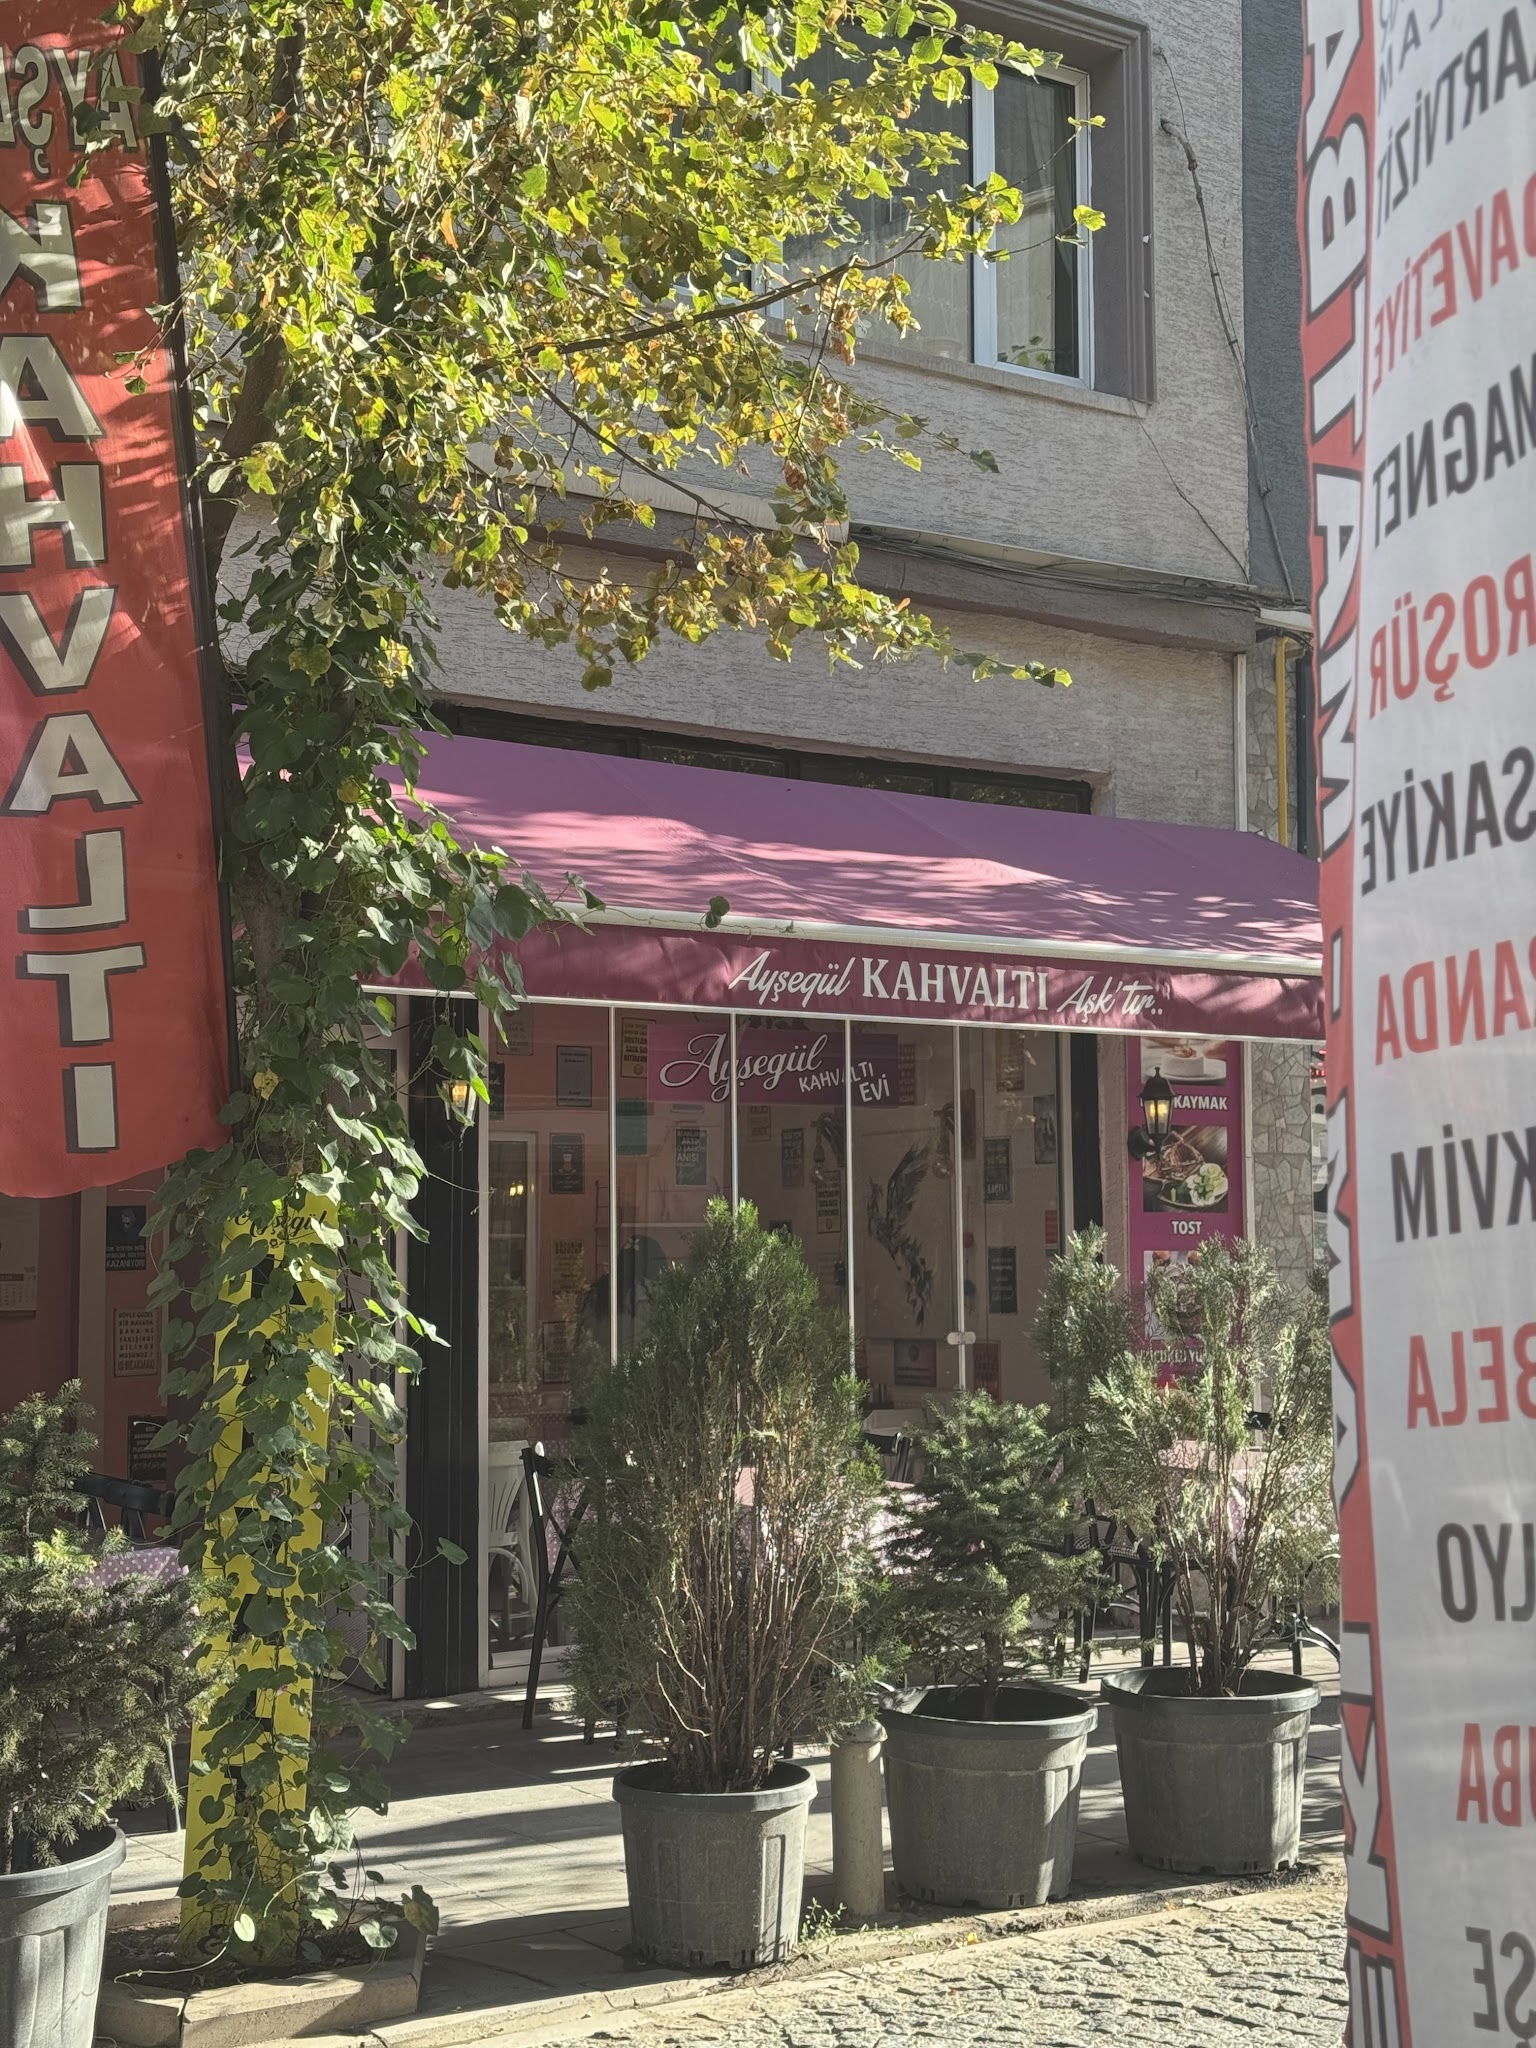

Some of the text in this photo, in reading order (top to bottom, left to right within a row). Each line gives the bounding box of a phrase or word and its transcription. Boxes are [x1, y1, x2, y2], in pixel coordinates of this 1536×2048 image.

[729, 950, 855, 1008] Ayşegül
[862, 957, 1049, 1011] KAHVALTI
[659, 1033, 828, 1103] Ayşegül
[859, 1073, 891, 1103] EVİ
[1173, 1095, 1228, 1110] KAYMAK
[1171, 1220, 1202, 1235] TOST
